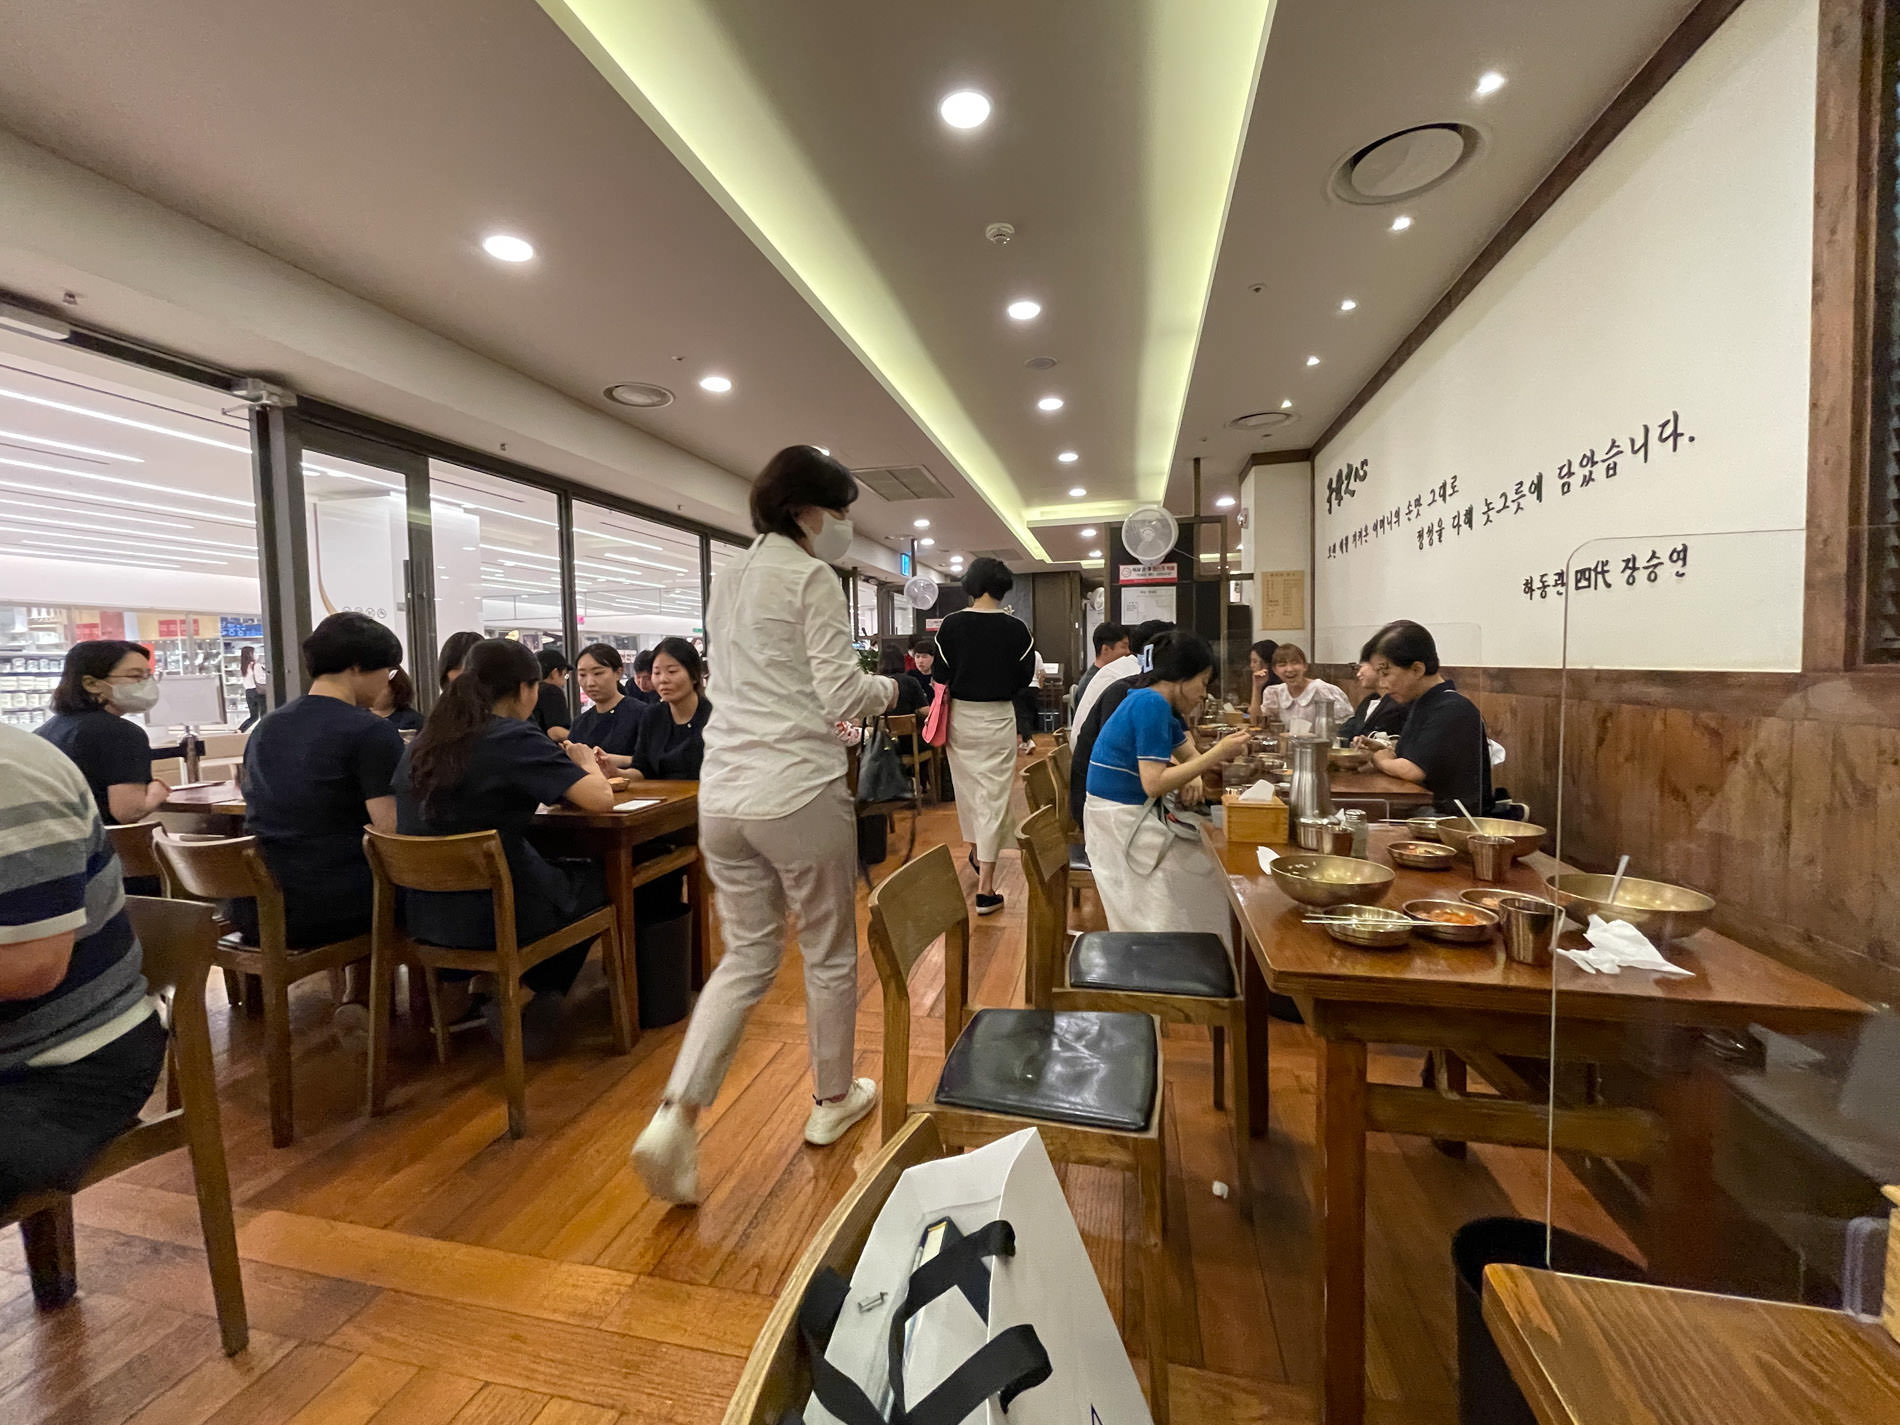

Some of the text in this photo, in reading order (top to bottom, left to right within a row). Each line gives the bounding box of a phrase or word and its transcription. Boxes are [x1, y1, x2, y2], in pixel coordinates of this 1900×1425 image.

[1372, 506, 1401, 538] 어머니의
[1405, 494, 1423, 522] 손맛
[1427, 475, 1460, 506] 그대로
[1416, 411, 1697, 550] 정성을 다해 놋그릇에 담았습니다.
[1523, 543, 1689, 601] 하동관 四代 장승연
